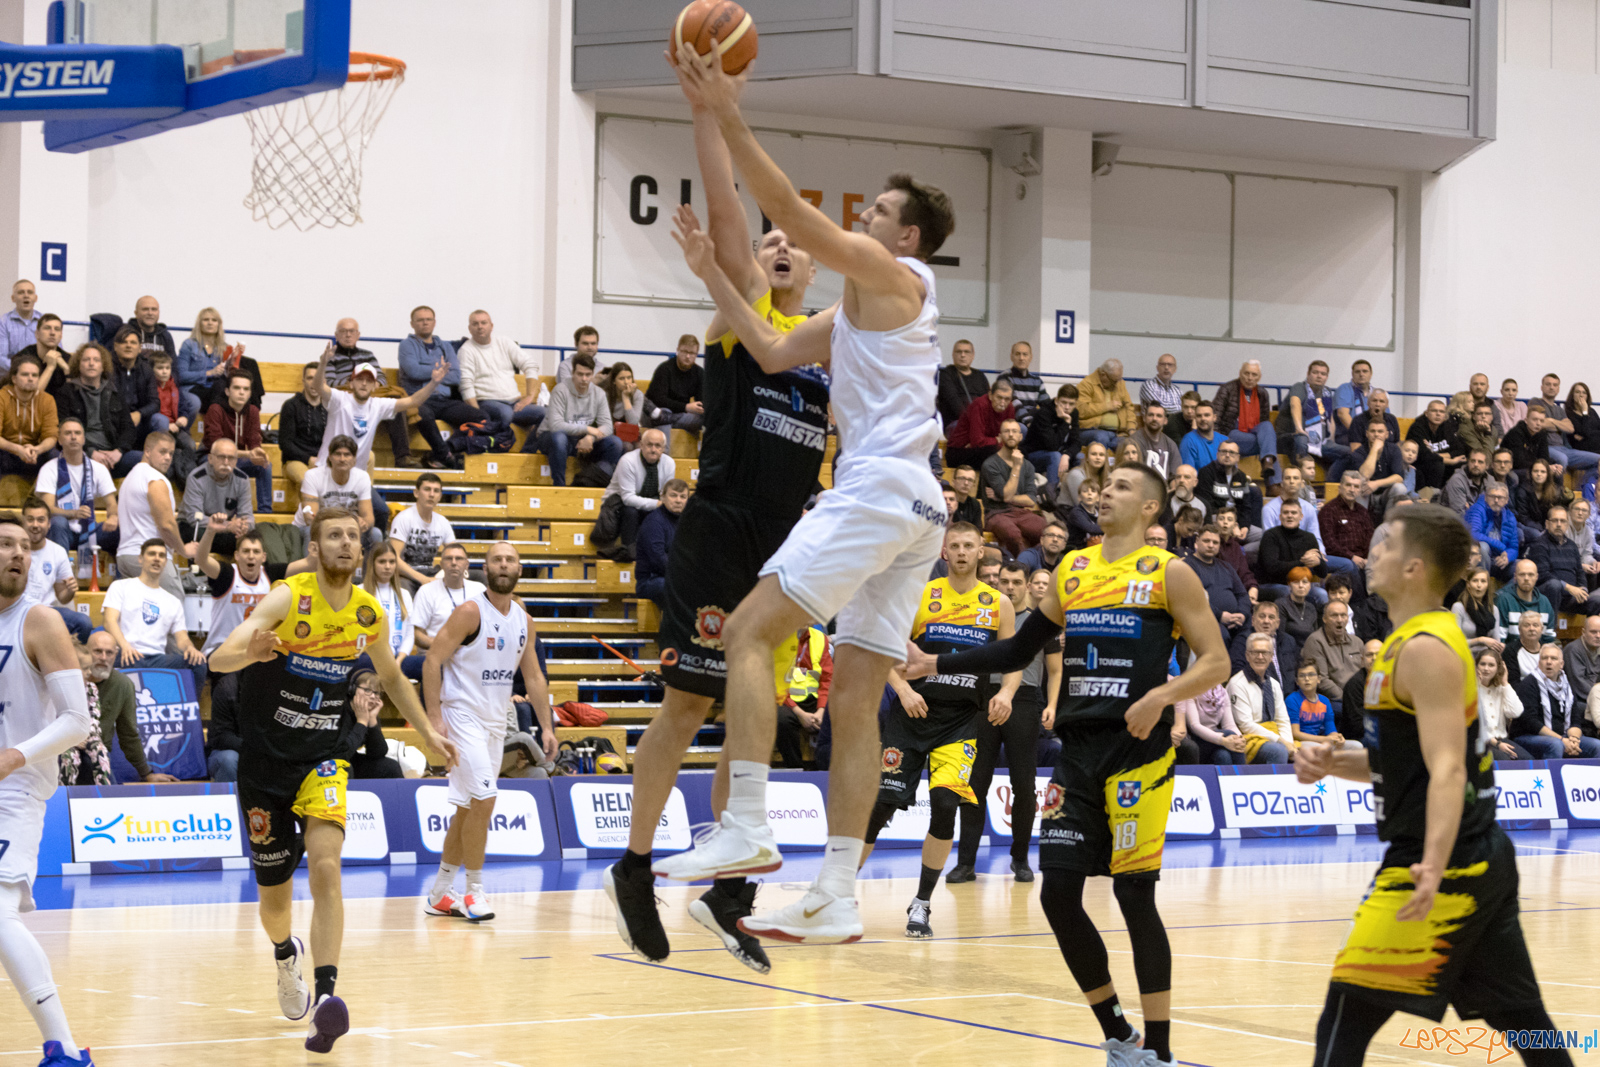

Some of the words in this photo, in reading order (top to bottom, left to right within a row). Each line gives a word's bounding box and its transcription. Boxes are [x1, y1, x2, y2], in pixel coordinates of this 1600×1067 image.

[0, 59, 115, 98] YSTEM
[46, 248, 62, 276] C
[1059, 315, 1072, 339] B
[754, 414, 778, 432] BDS
[776, 415, 825, 451] INSTA
[1123, 579, 1153, 605] 18
[79, 605, 88, 613] 15
[975, 607, 993, 627] 25
[1070, 613, 1136, 627] RAWLPLUG
[937, 625, 986, 641] RAWLPLUG
[0, 645, 13, 673] 7
[681, 653, 728, 671] PRO-FAM
[481, 669, 513, 681] BIOFA
[938, 674, 976, 689] INSTA
[136, 701, 200, 724] SKET
[139, 721, 184, 734] ZNAŃ
[324, 786, 339, 807] 9
[1232, 791, 1325, 816] POZnan
[1346, 789, 1374, 813] PO
[1571, 787, 1600, 802] BIO
[123, 812, 232, 835] funclub
[127, 834, 167, 843] biuro
[173, 832, 233, 843] podróży
[1040, 828, 1085, 842] O-FAMILIA
[1114, 820, 1138, 851] 18
